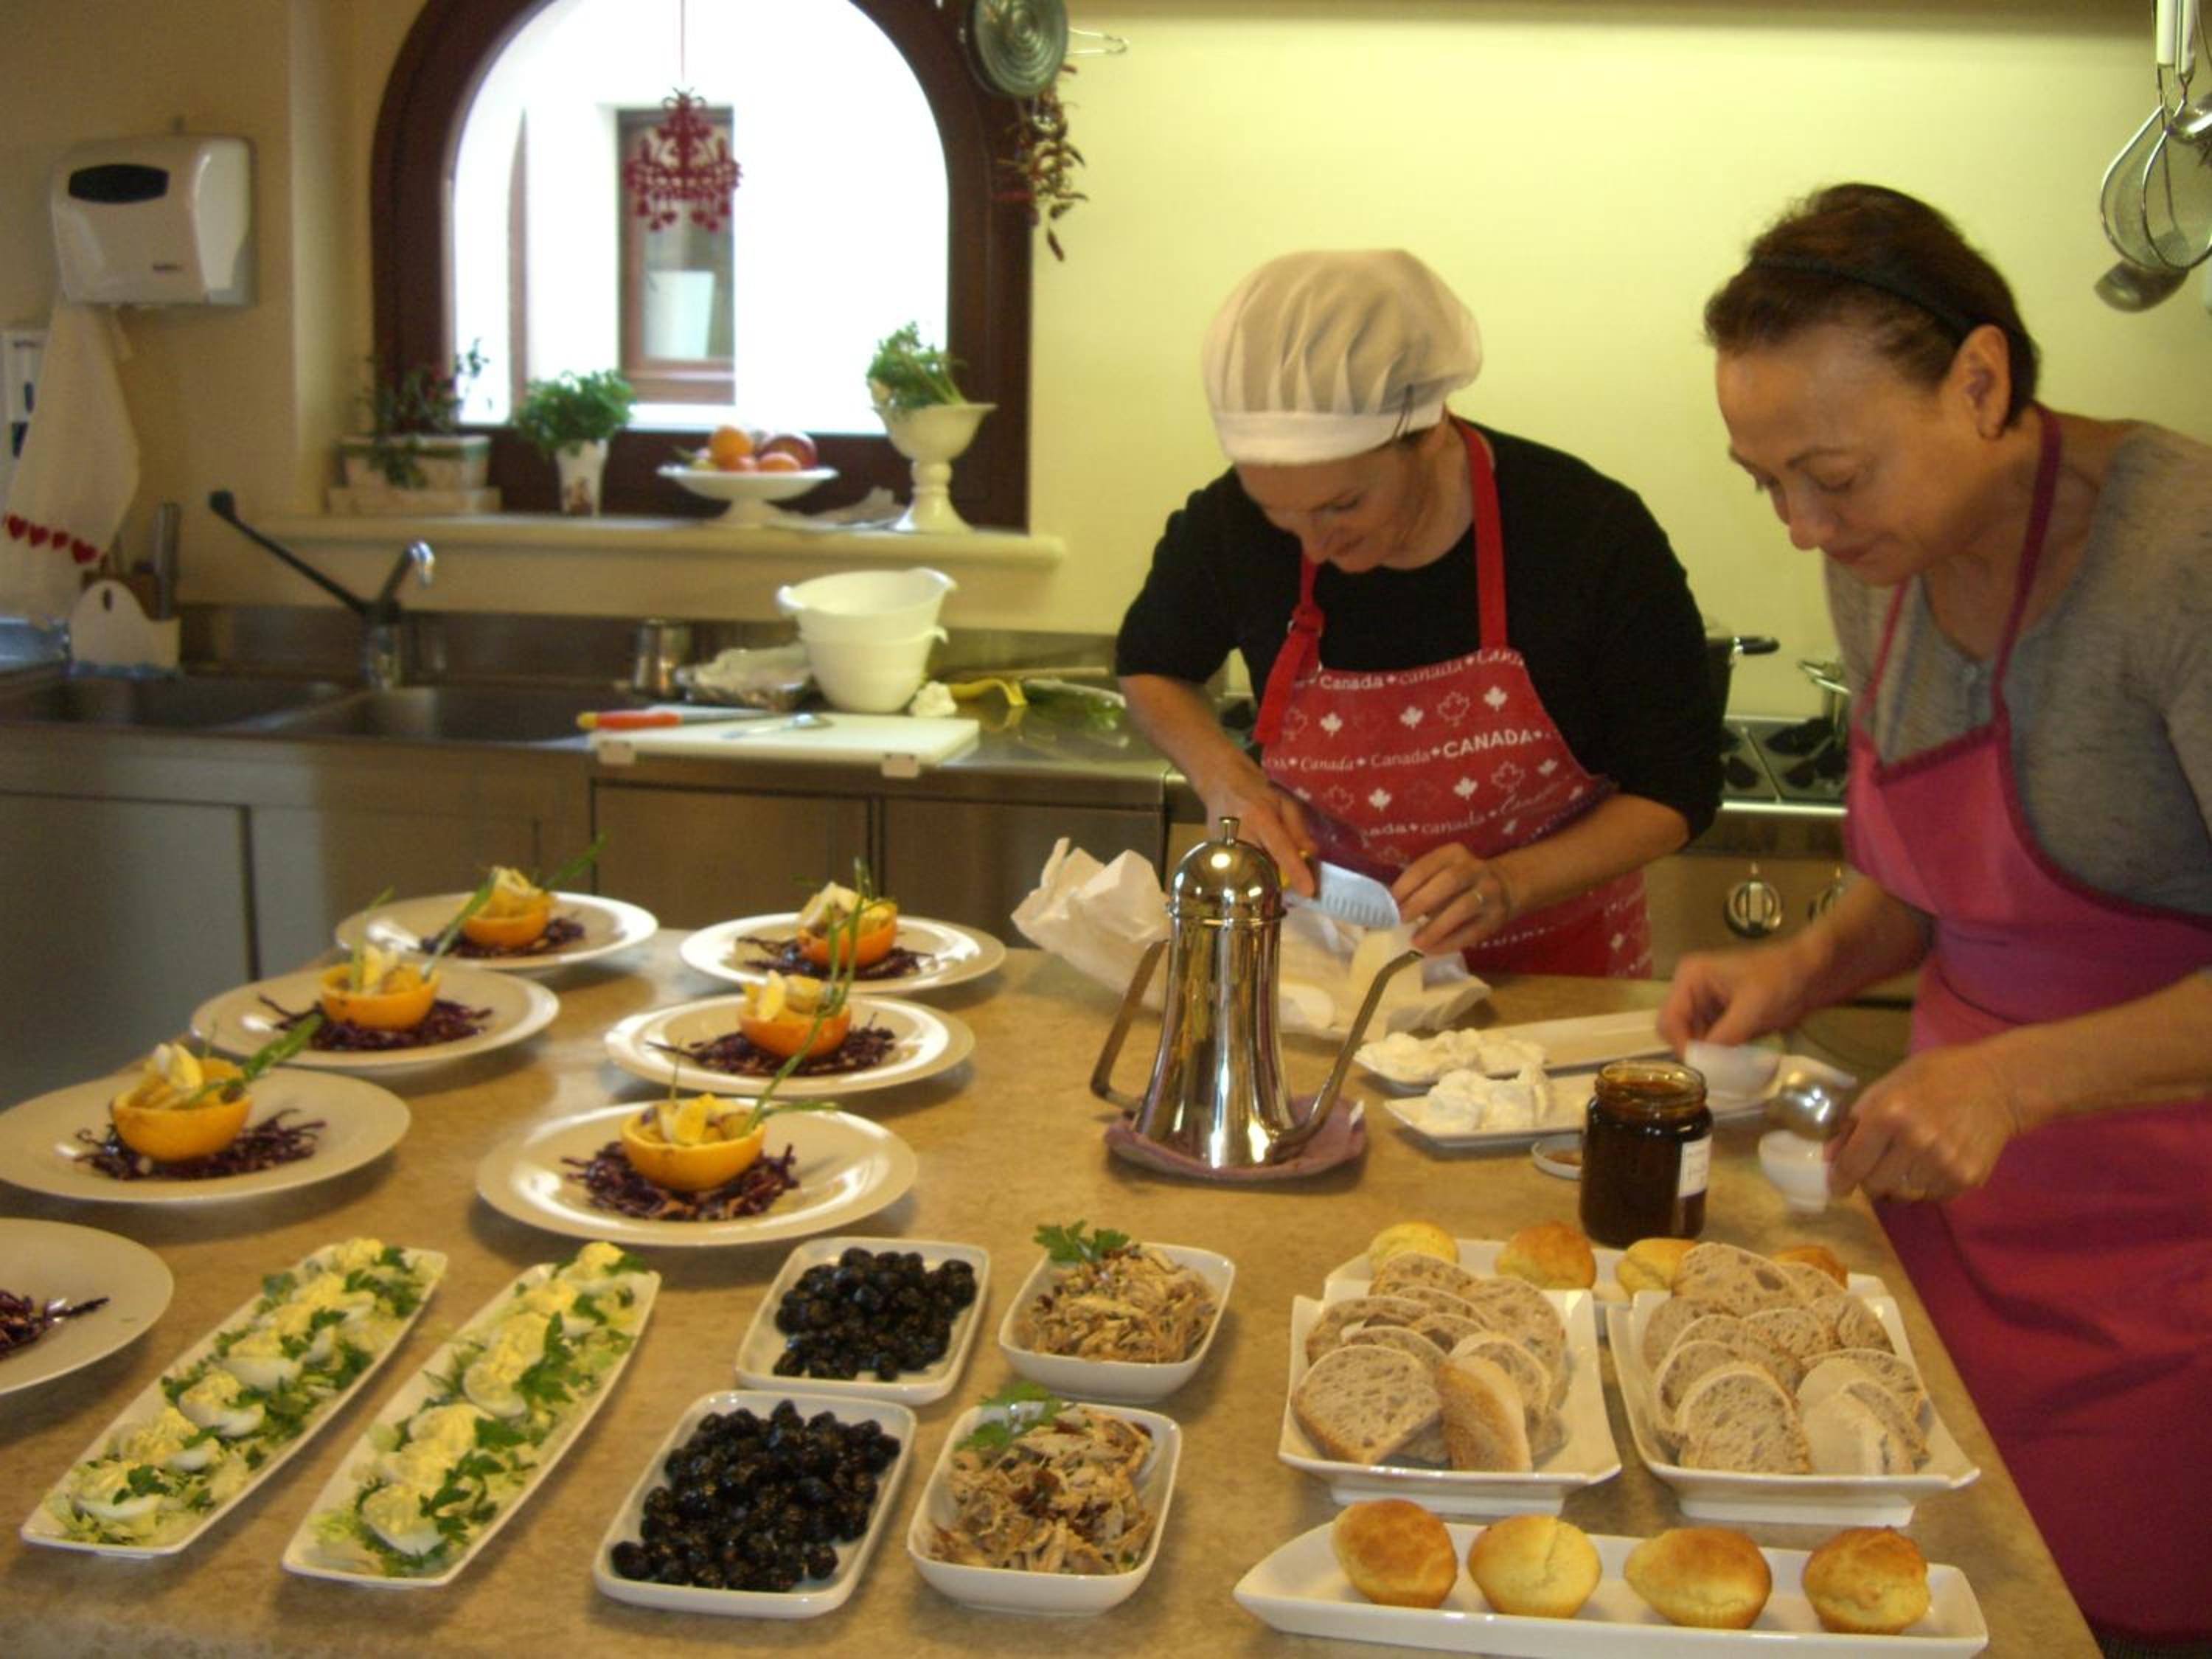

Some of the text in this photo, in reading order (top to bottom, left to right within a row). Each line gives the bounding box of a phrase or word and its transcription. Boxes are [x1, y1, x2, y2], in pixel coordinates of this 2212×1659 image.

[1321, 674, 1384, 690] Canada
[1400, 659, 1462, 685] canada
[1301, 755, 1354, 772] Canada
[1371, 748, 1430, 768] Canada
[1443, 729, 1533, 758] CANADA
